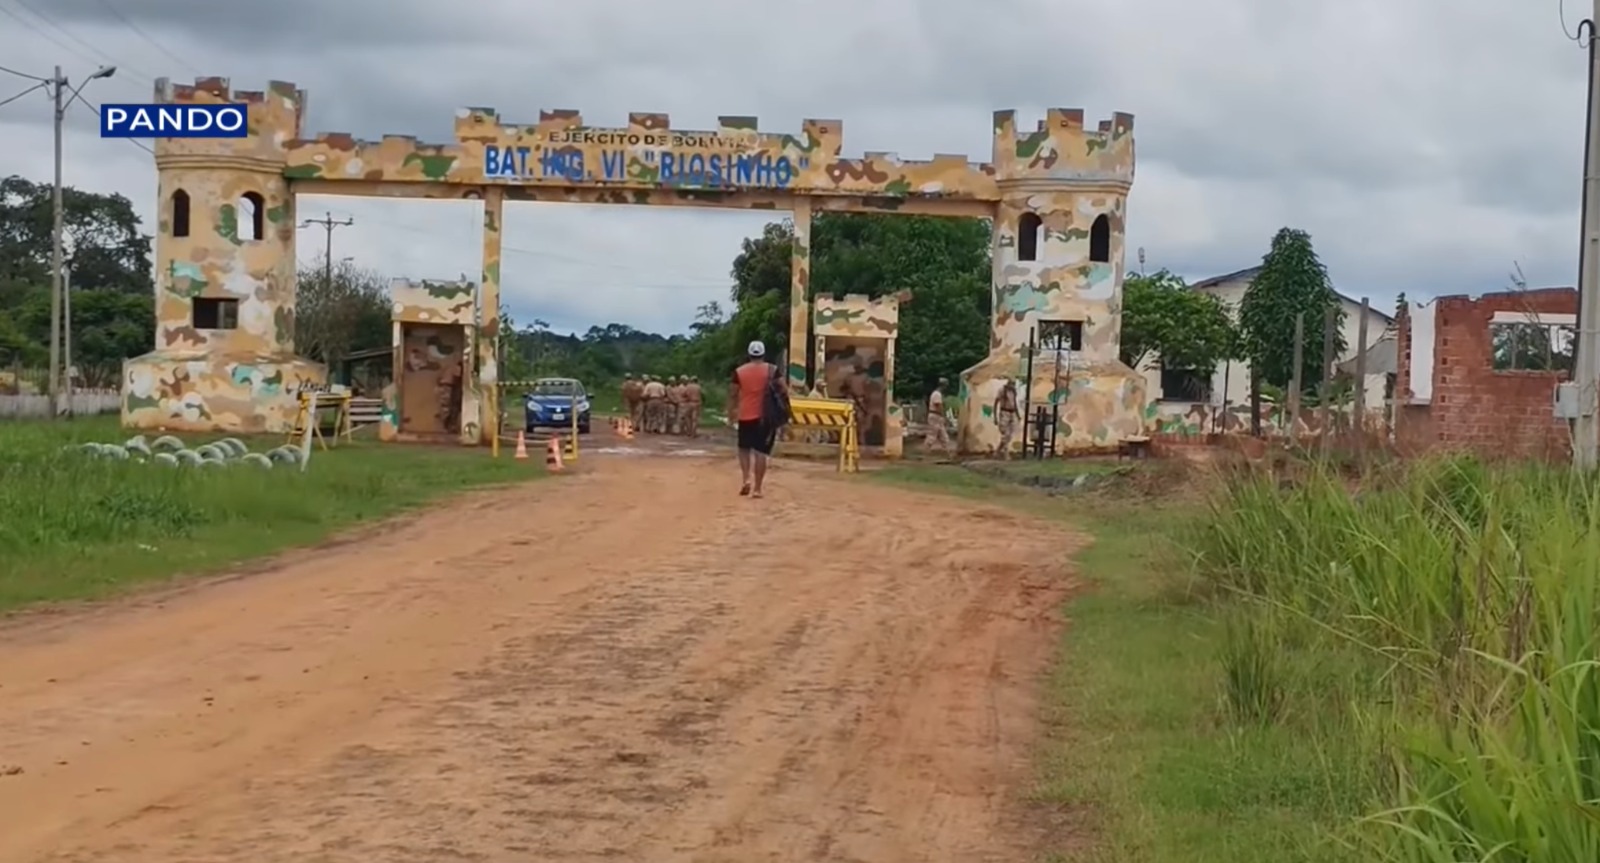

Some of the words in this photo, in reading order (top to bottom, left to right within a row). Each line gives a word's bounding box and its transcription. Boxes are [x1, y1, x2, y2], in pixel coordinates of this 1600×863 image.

[644, 134, 668, 147] DE
[485, 145, 533, 175] BAT.
[602, 149, 625, 179] VI
